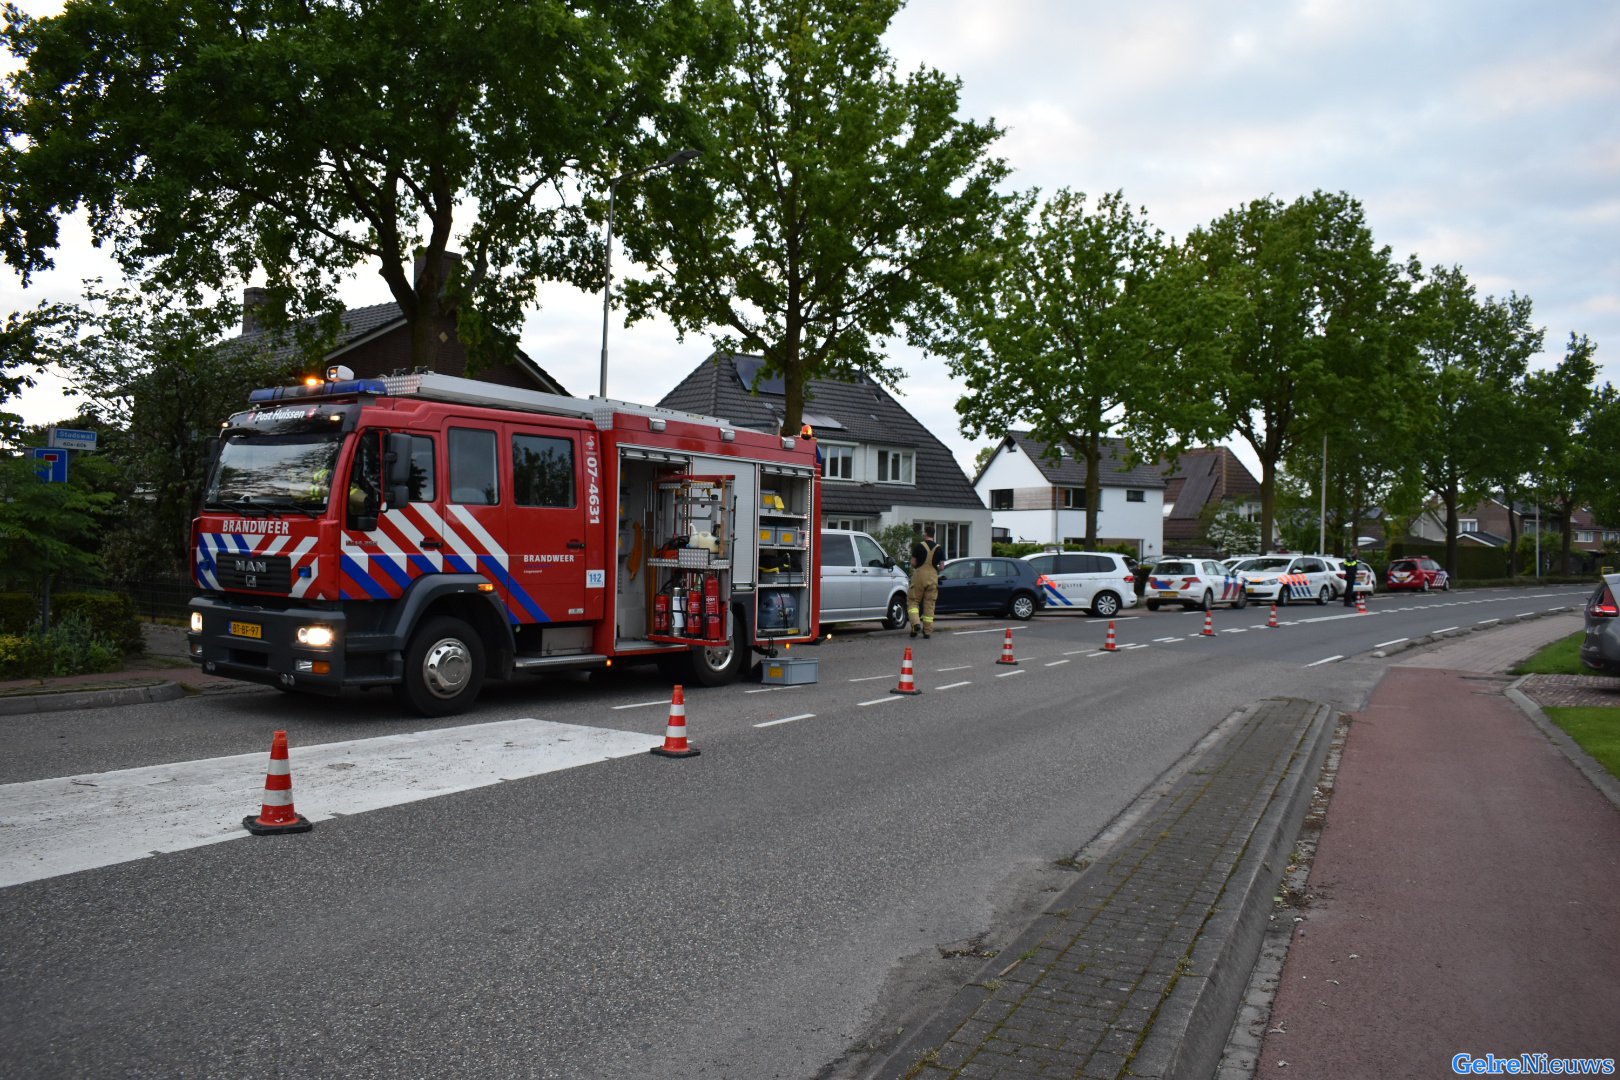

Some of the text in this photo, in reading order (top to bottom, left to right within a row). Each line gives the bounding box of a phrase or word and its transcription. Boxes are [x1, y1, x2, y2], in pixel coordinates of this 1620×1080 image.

[255, 409, 305, 421] Post Huissen
[58, 431, 93, 440] Stadswal
[586, 456, 600, 524] 07-4631
[222, 520, 289, 534] BRANDWEER
[523, 554, 575, 562] BRANDWEER
[235, 560, 267, 573] MAN
[589, 573, 602, 582] 112
[232, 623, 260, 636] BT-BF-97
